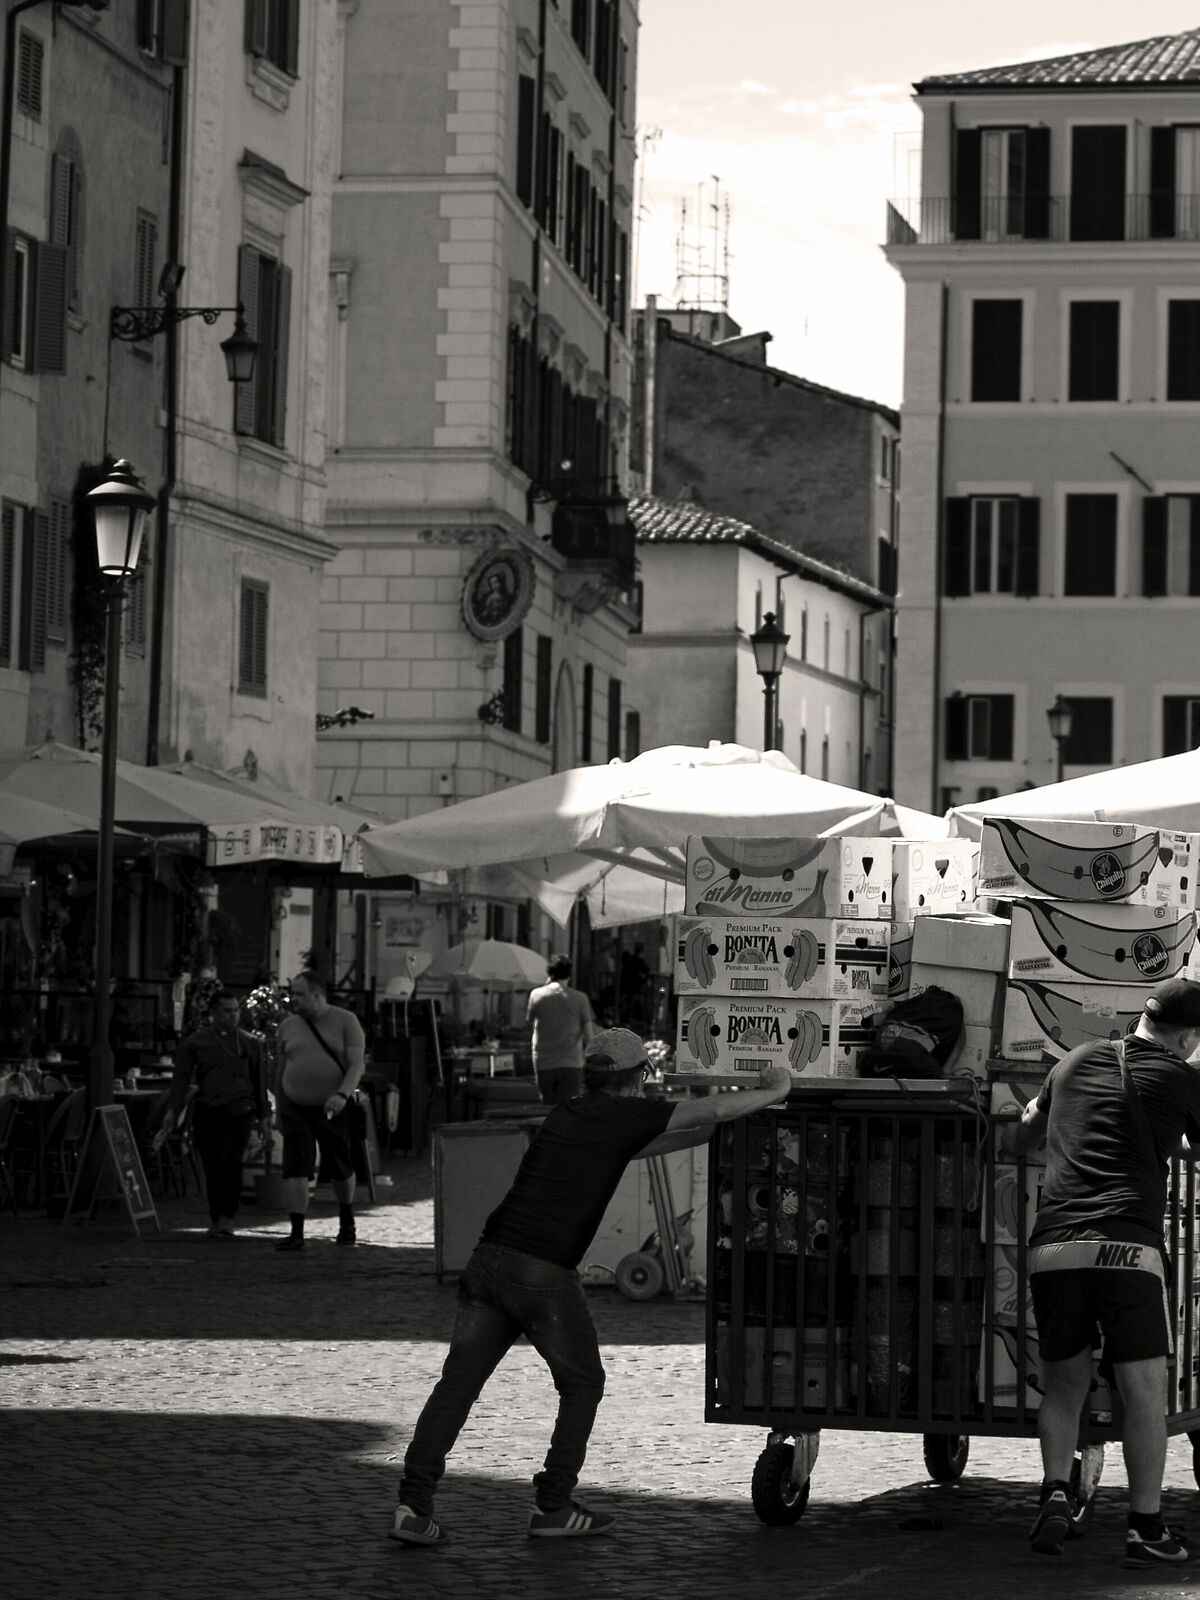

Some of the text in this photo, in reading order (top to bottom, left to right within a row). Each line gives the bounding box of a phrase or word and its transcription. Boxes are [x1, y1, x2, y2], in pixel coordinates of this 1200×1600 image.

[726, 923, 783, 933] PREMIUM PACK
[724, 935, 781, 964] BONITA
[1137, 950, 1168, 972] Chiquita
[730, 1003, 787, 1014] PREMIUM PACK
[726, 1015, 785, 1045] BONITA
[1095, 1243, 1143, 1269] NIKE
